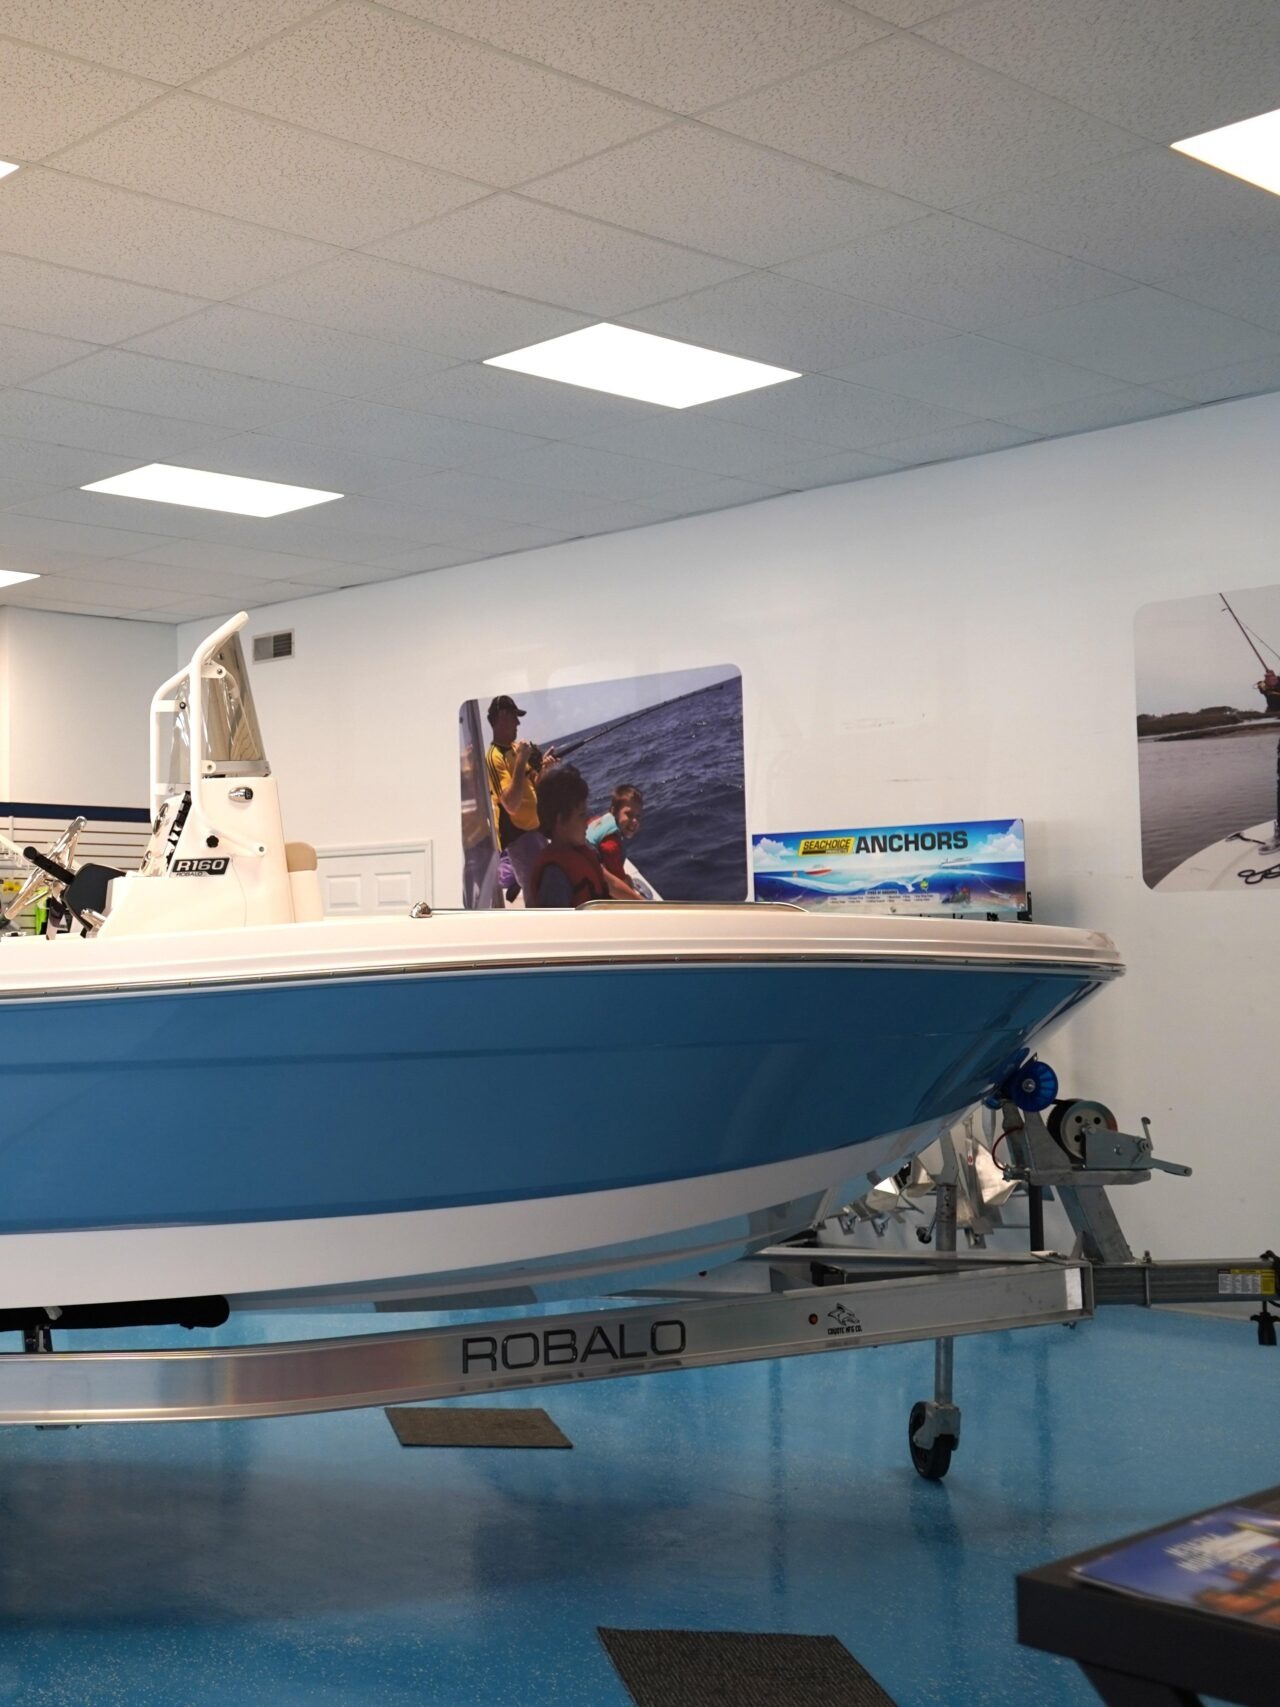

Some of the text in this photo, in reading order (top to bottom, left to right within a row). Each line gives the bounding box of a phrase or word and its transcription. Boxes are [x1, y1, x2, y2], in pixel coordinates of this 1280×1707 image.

[803, 831, 969, 854] SEACHOICE ANCHORS
[176, 860, 225, 871] R160
[462, 1319, 686, 1374] ROBALO
